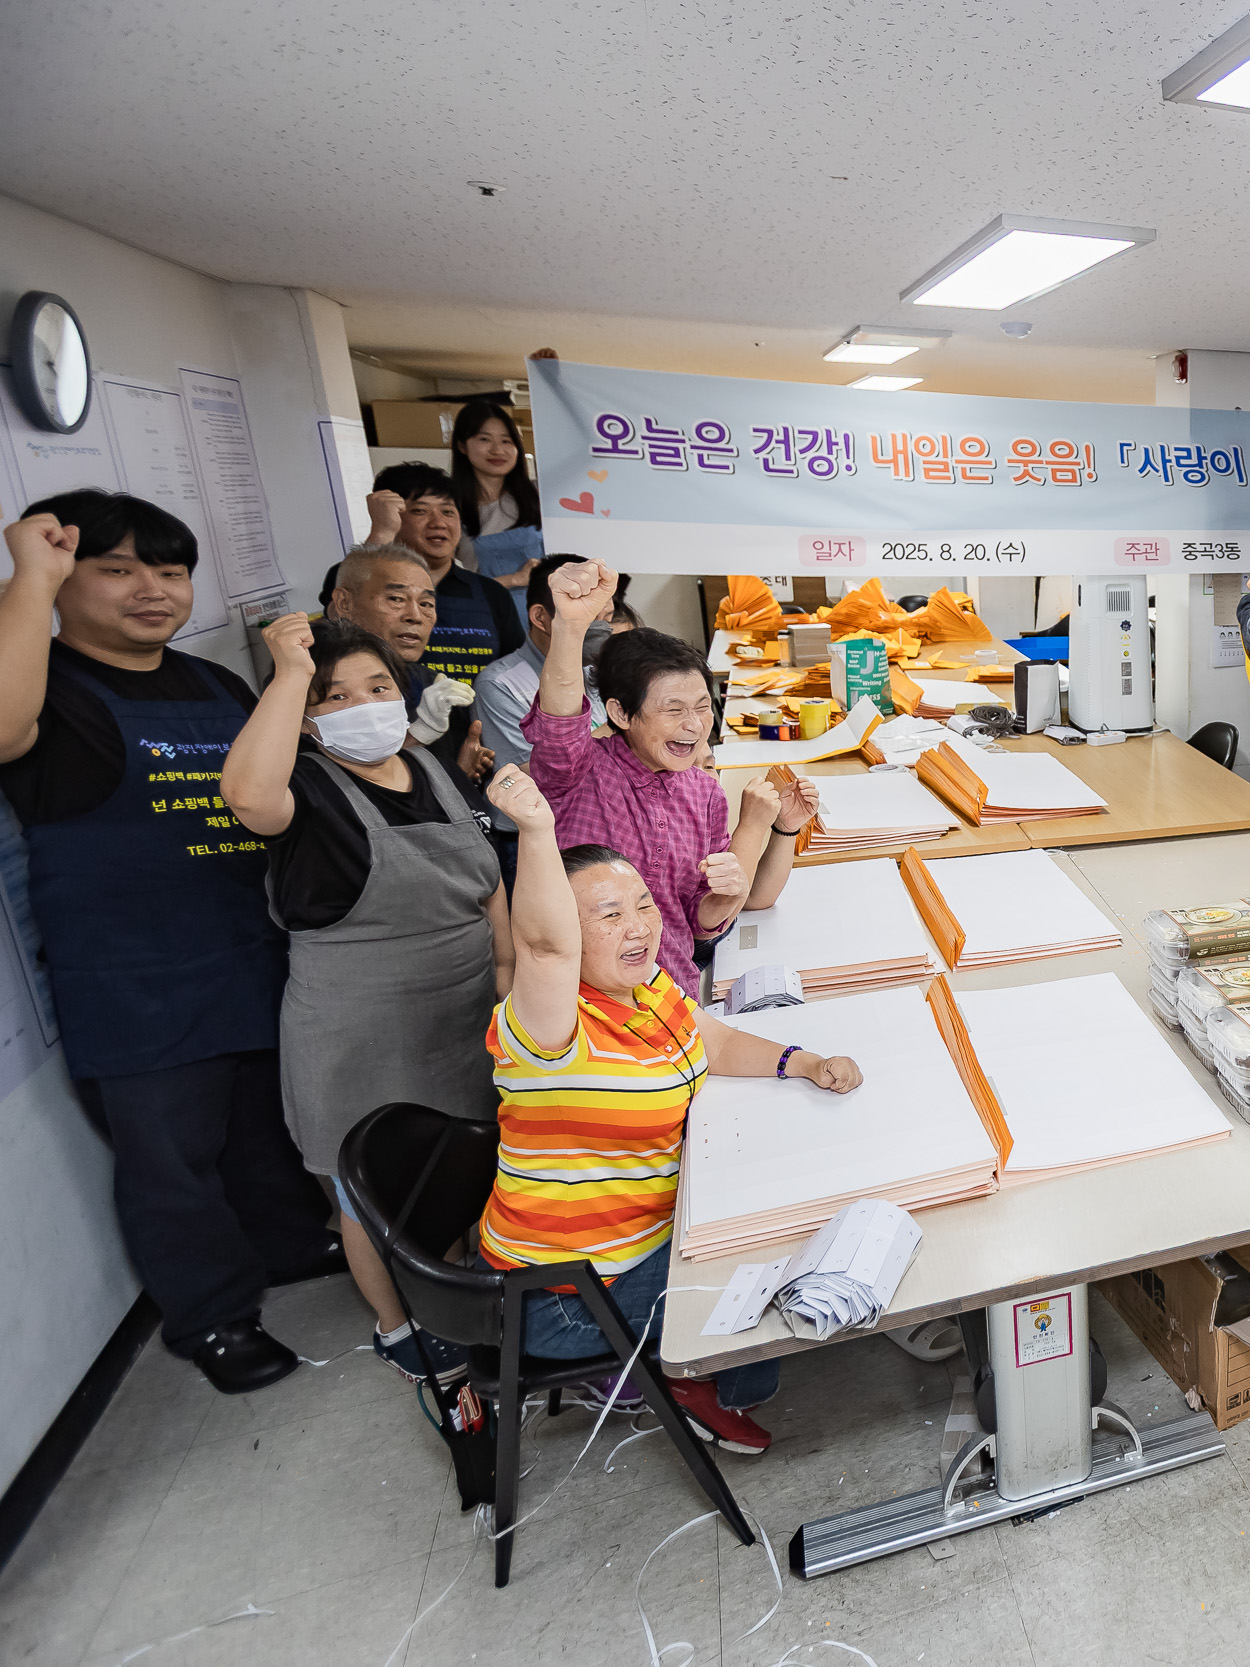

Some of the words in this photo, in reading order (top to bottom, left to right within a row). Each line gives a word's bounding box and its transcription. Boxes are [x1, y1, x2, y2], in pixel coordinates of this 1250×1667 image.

[592, 413, 737, 472] 오늘은
[751, 425, 856, 478] 건강!
[869, 432, 996, 482] 내일은
[1005, 438, 1097, 485] 웃음!
[1118, 441, 1246, 486] 「사랑이
[811, 539, 855, 562] 일자
[881, 542, 934, 561] 2025.
[939, 542, 957, 561] 8.
[1123, 541, 1160, 562] 주관
[1181, 541, 1242, 561] 중곡3동
[152, 799, 168, 813] 넌
[171, 796, 211, 810] 쇼핑백
[212, 796, 229, 809] 들
[205, 815, 232, 828] 제일
[186, 844, 218, 856] TEL.
[219, 841, 268, 854] 02-468-4
